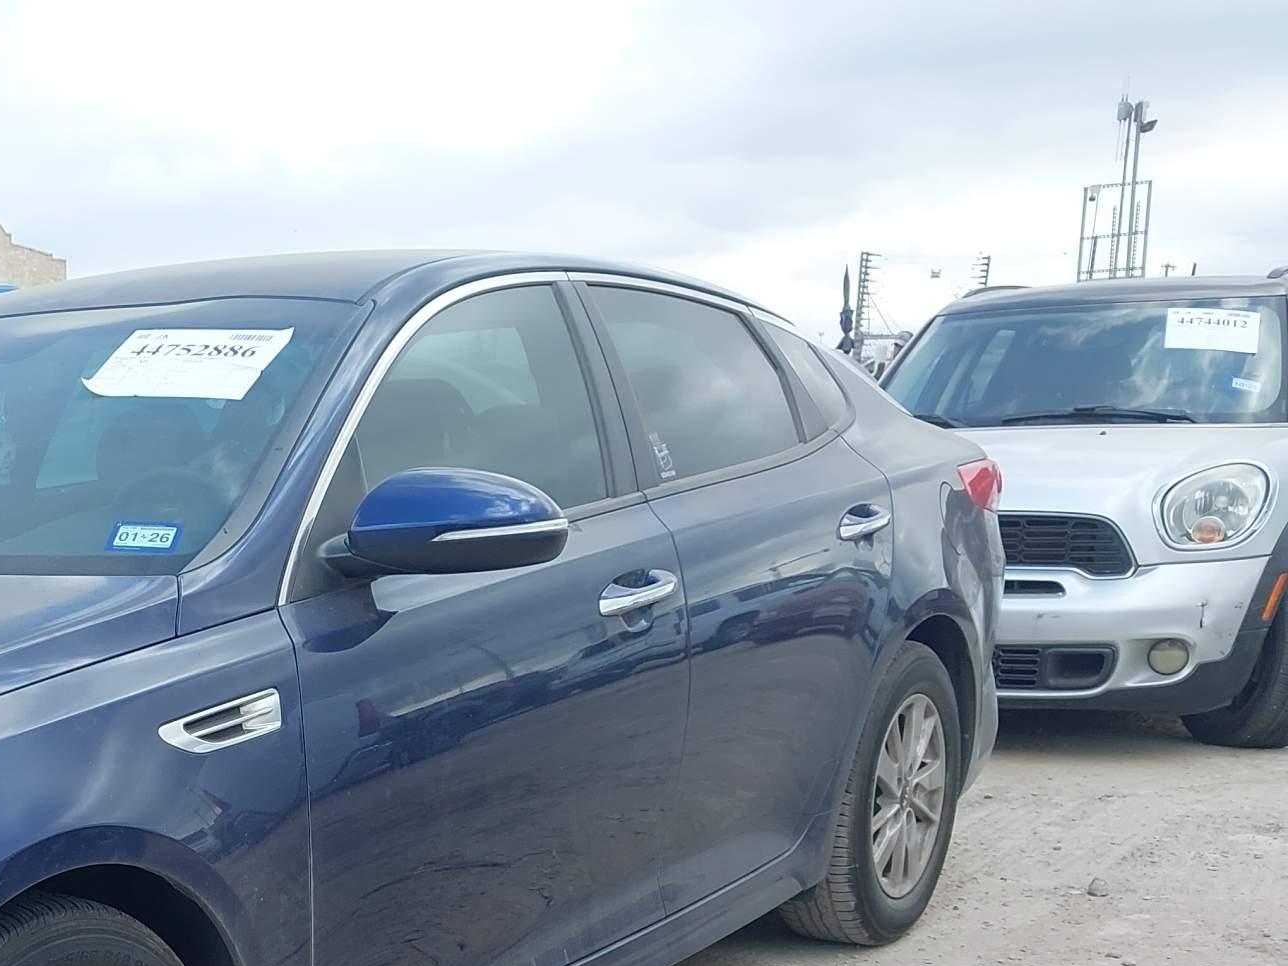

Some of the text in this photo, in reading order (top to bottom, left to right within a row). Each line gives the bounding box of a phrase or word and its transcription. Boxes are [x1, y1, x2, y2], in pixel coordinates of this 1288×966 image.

[1177, 317, 1248, 328] 44744012
[130, 343, 257, 358] 44752886
[119, 531, 171, 543] 01 26
